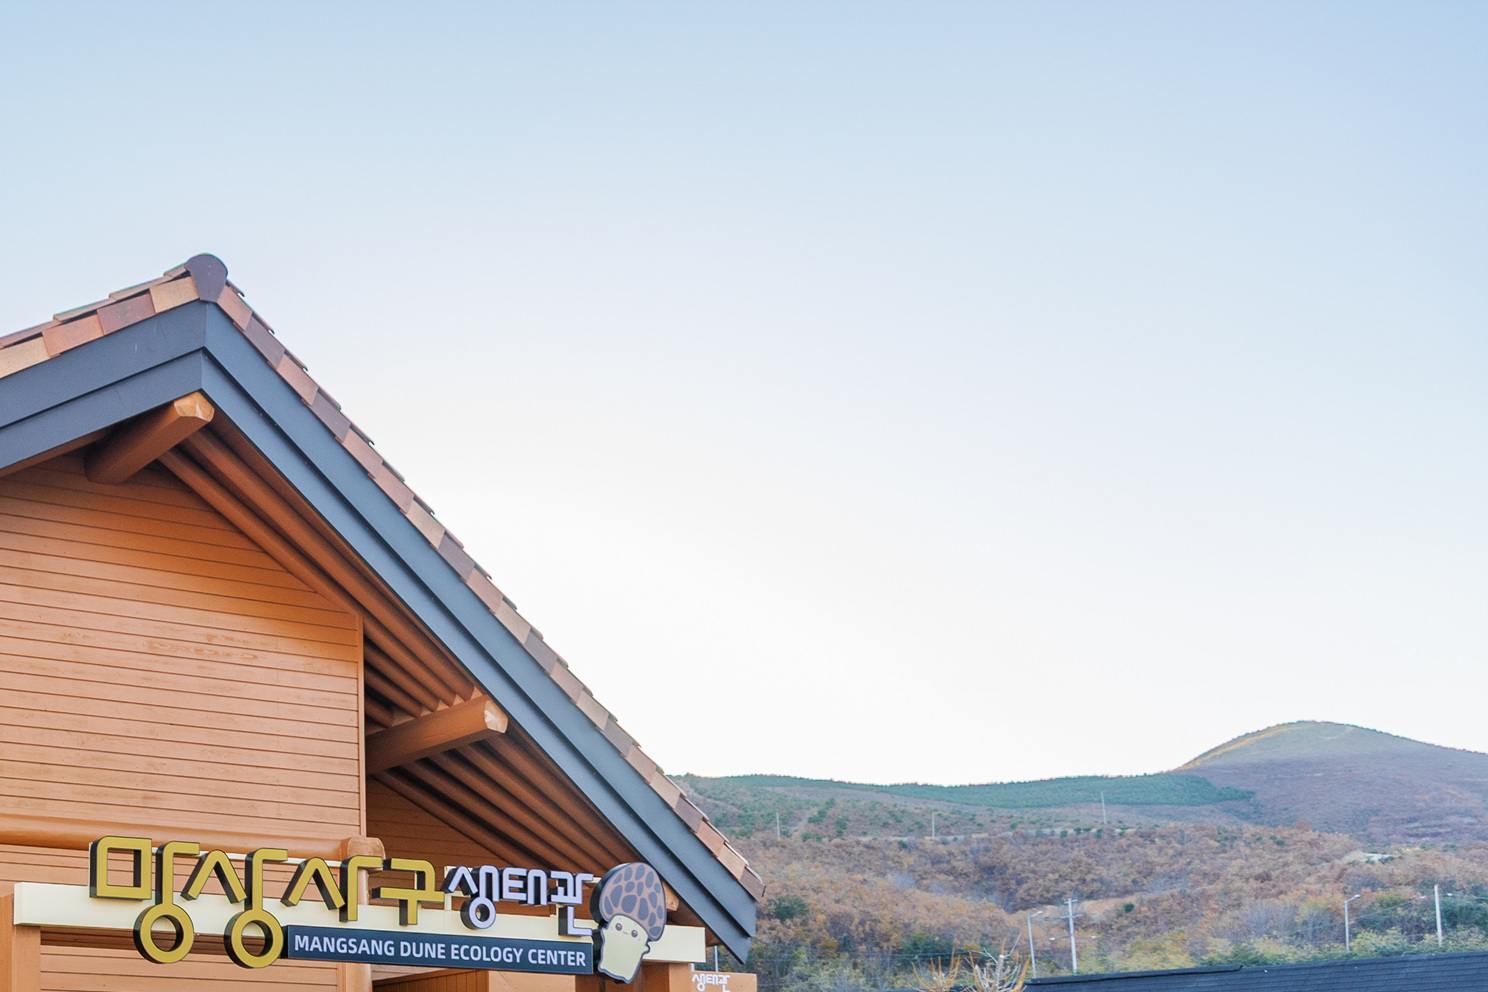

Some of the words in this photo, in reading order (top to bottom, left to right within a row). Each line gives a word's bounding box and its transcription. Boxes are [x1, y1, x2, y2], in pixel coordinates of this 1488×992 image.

[89, 836, 445, 968] 망상사구
[442, 865, 594, 936] 생태관
[294, 935, 395, 957] MANGSANG
[400, 941, 446, 959] DUNE
[450, 944, 524, 963] ECOLOGY
[527, 949, 587, 967] CENTER
